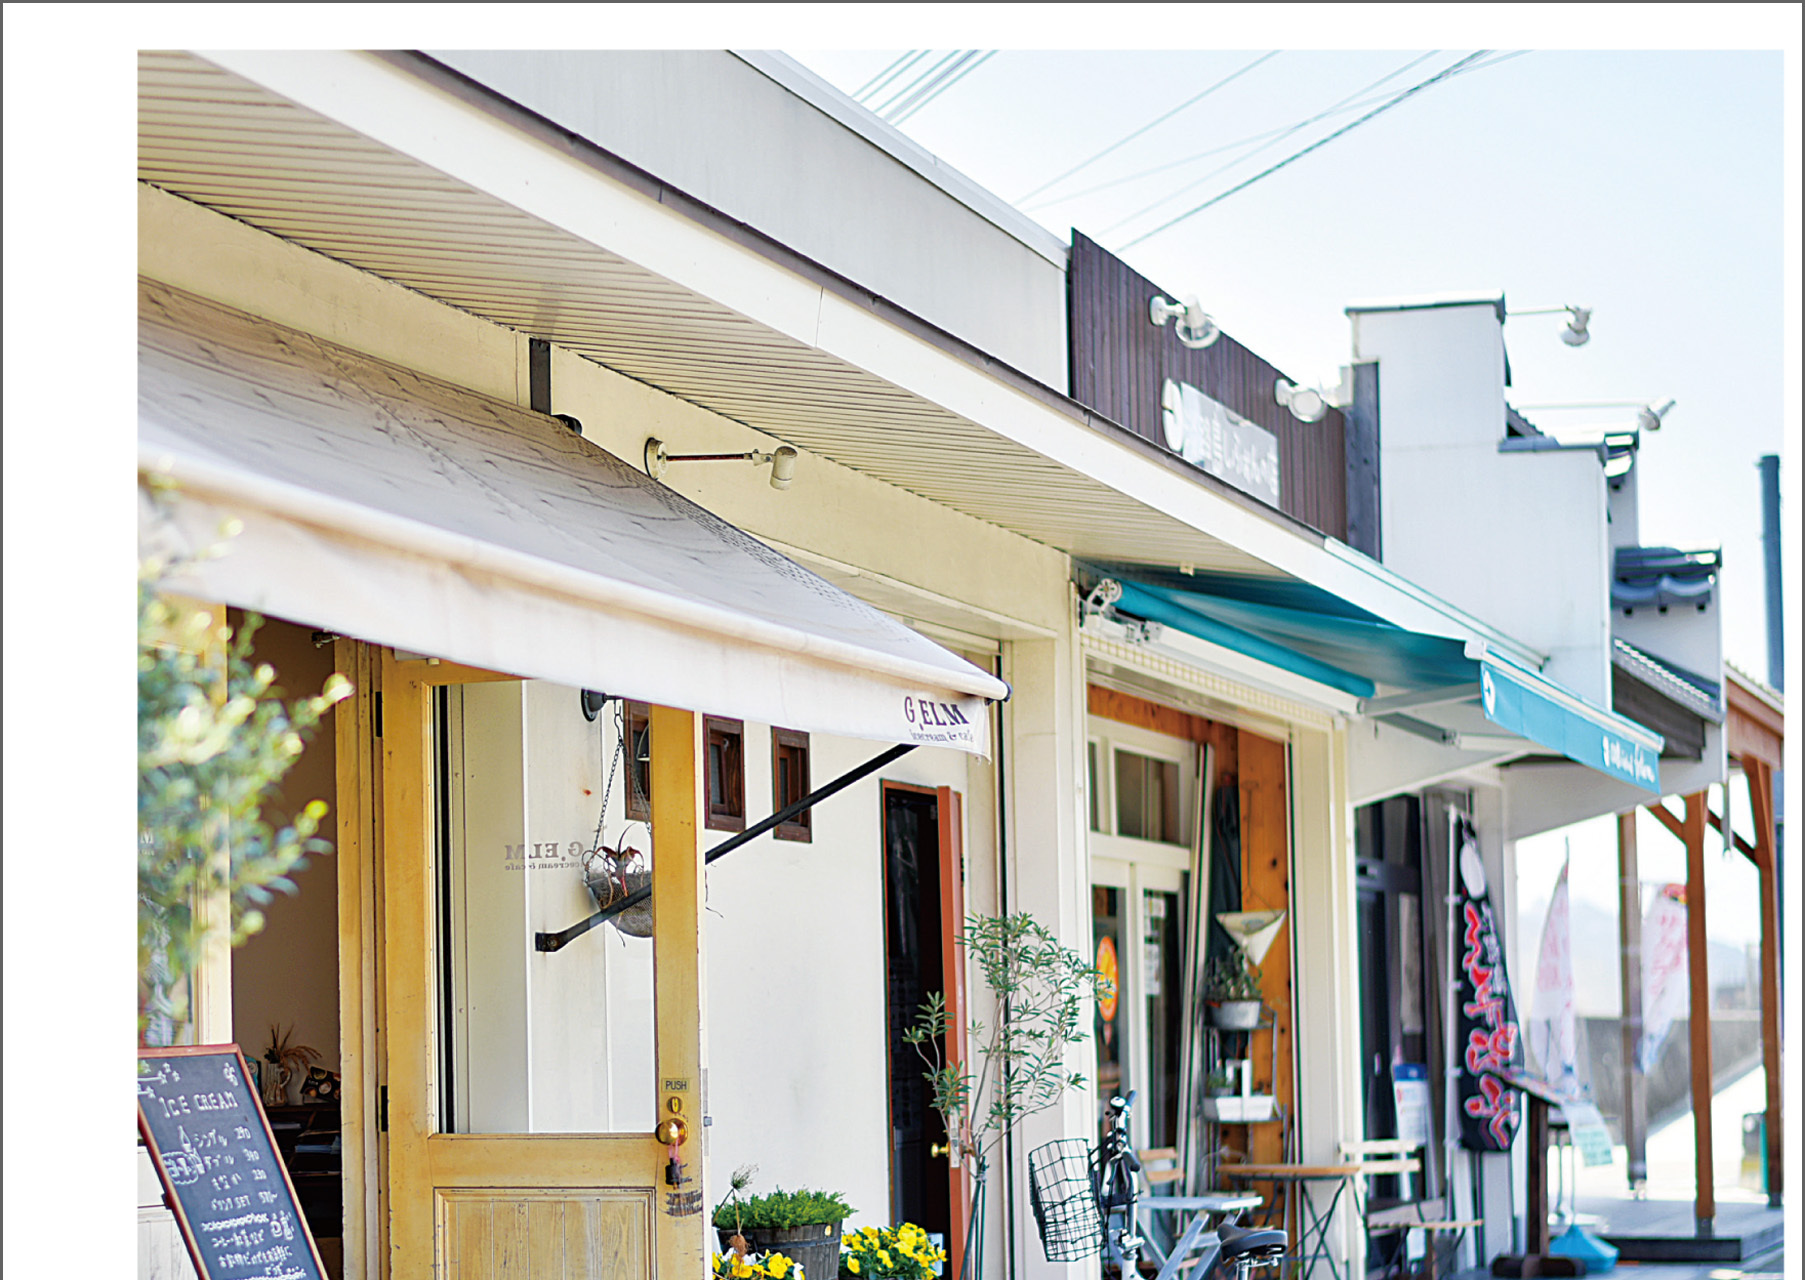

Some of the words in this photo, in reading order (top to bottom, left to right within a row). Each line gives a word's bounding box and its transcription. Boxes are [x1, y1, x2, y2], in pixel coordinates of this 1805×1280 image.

[665, 1080, 687, 1090] PUSH
[159, 1095, 191, 1118] ICE
[193, 1091, 238, 1111] CREAM
